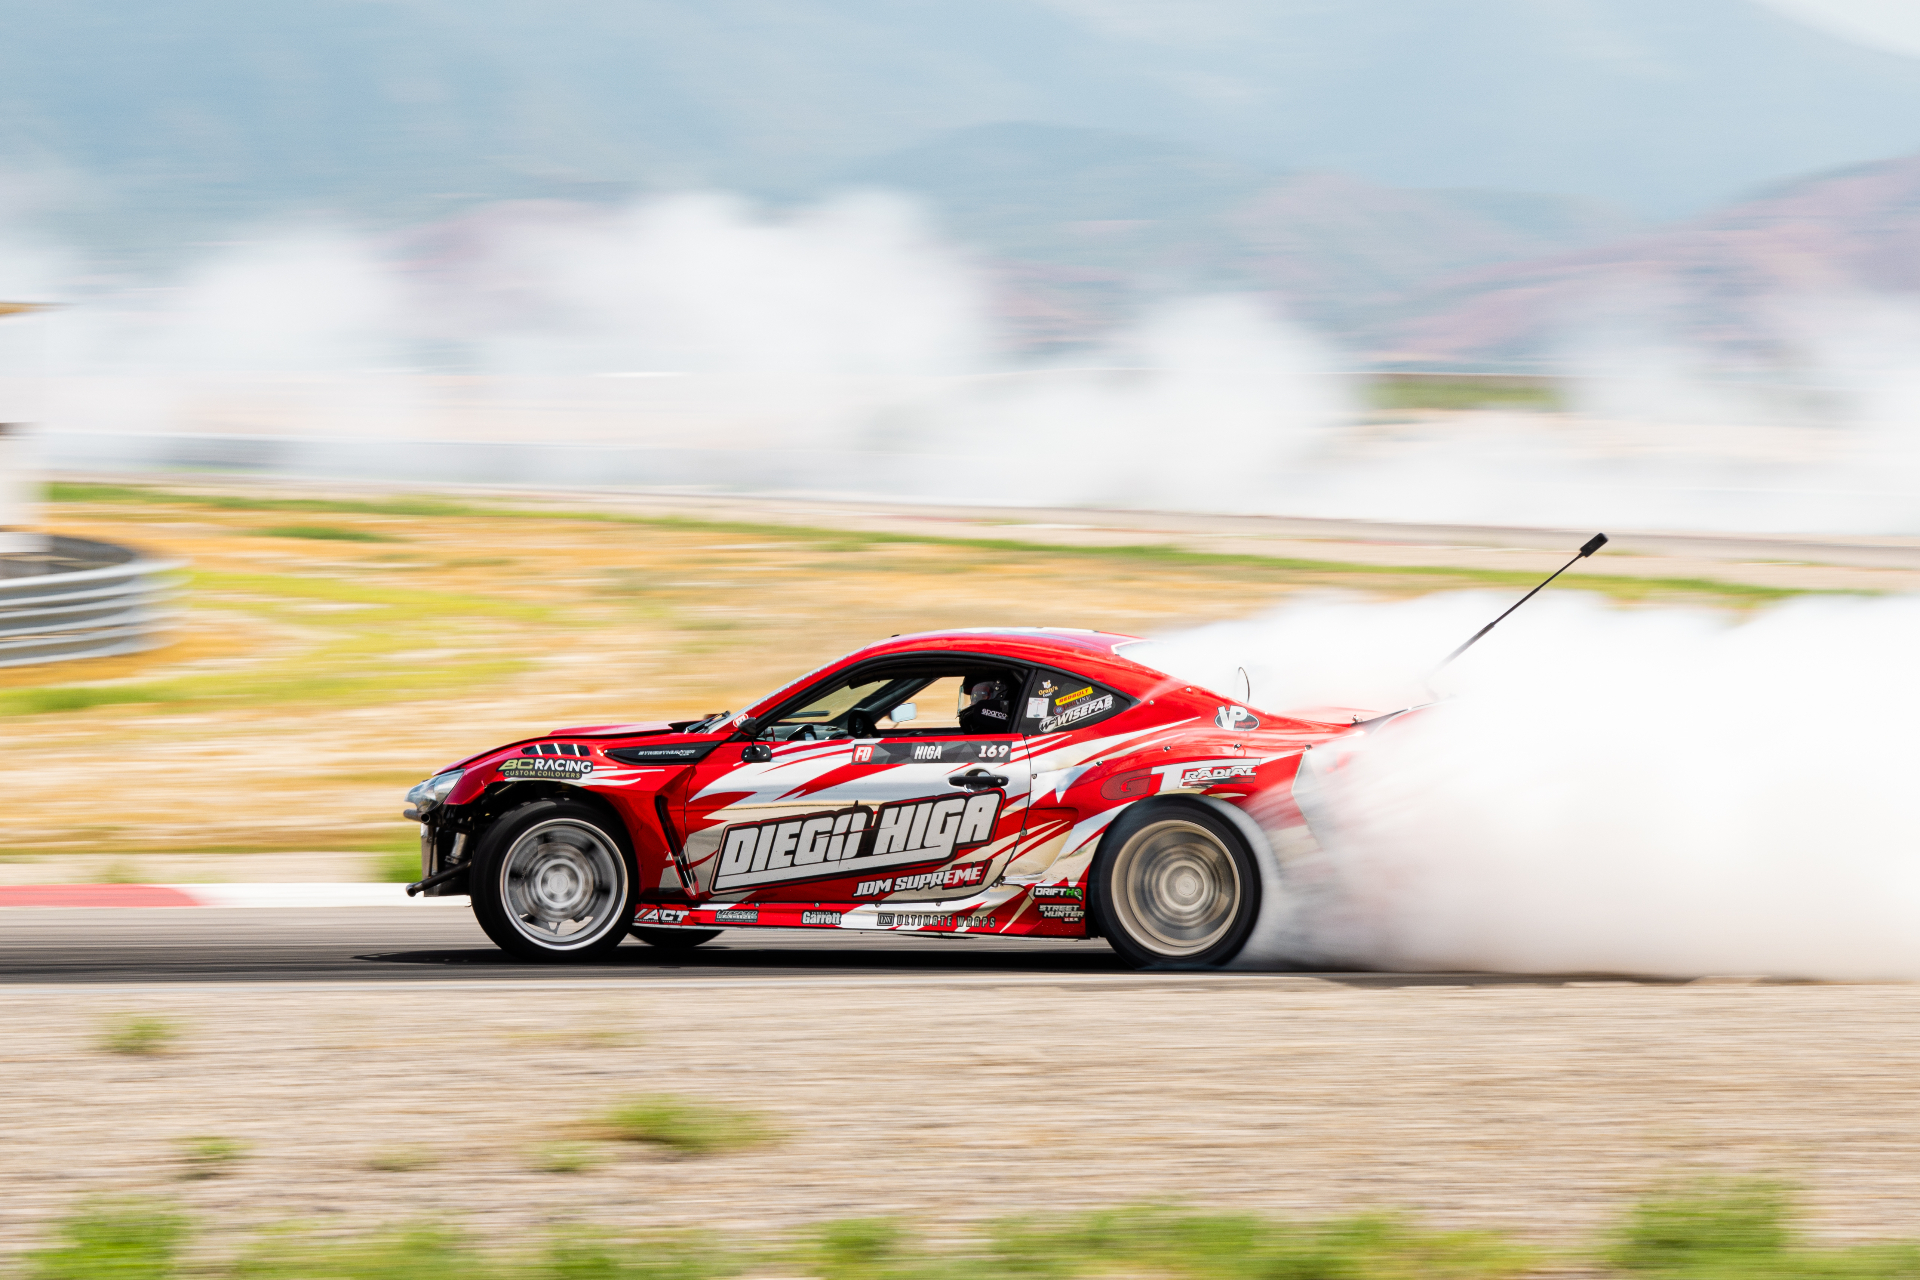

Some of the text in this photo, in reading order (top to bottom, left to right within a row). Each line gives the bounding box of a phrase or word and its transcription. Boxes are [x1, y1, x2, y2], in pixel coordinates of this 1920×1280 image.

[1057, 696, 1113, 726] WISEFAB
[1217, 705, 1248, 731] VP
[854, 746, 872, 761] FD
[914, 745, 942, 760] HIGA
[978, 745, 1009, 758] 169
[534, 758, 592, 773] RACING
[537, 770, 581, 779] COILOVERS
[1100, 758, 1261, 800] GT RADIAL
[718, 793, 1000, 877] DIEGO HIGA
[852, 866, 984, 897] JDM SUPREME
[802, 911, 841, 924] Garrett
[896, 915, 952, 926] ULTIMATE
[957, 916, 996, 928] WRAPS
